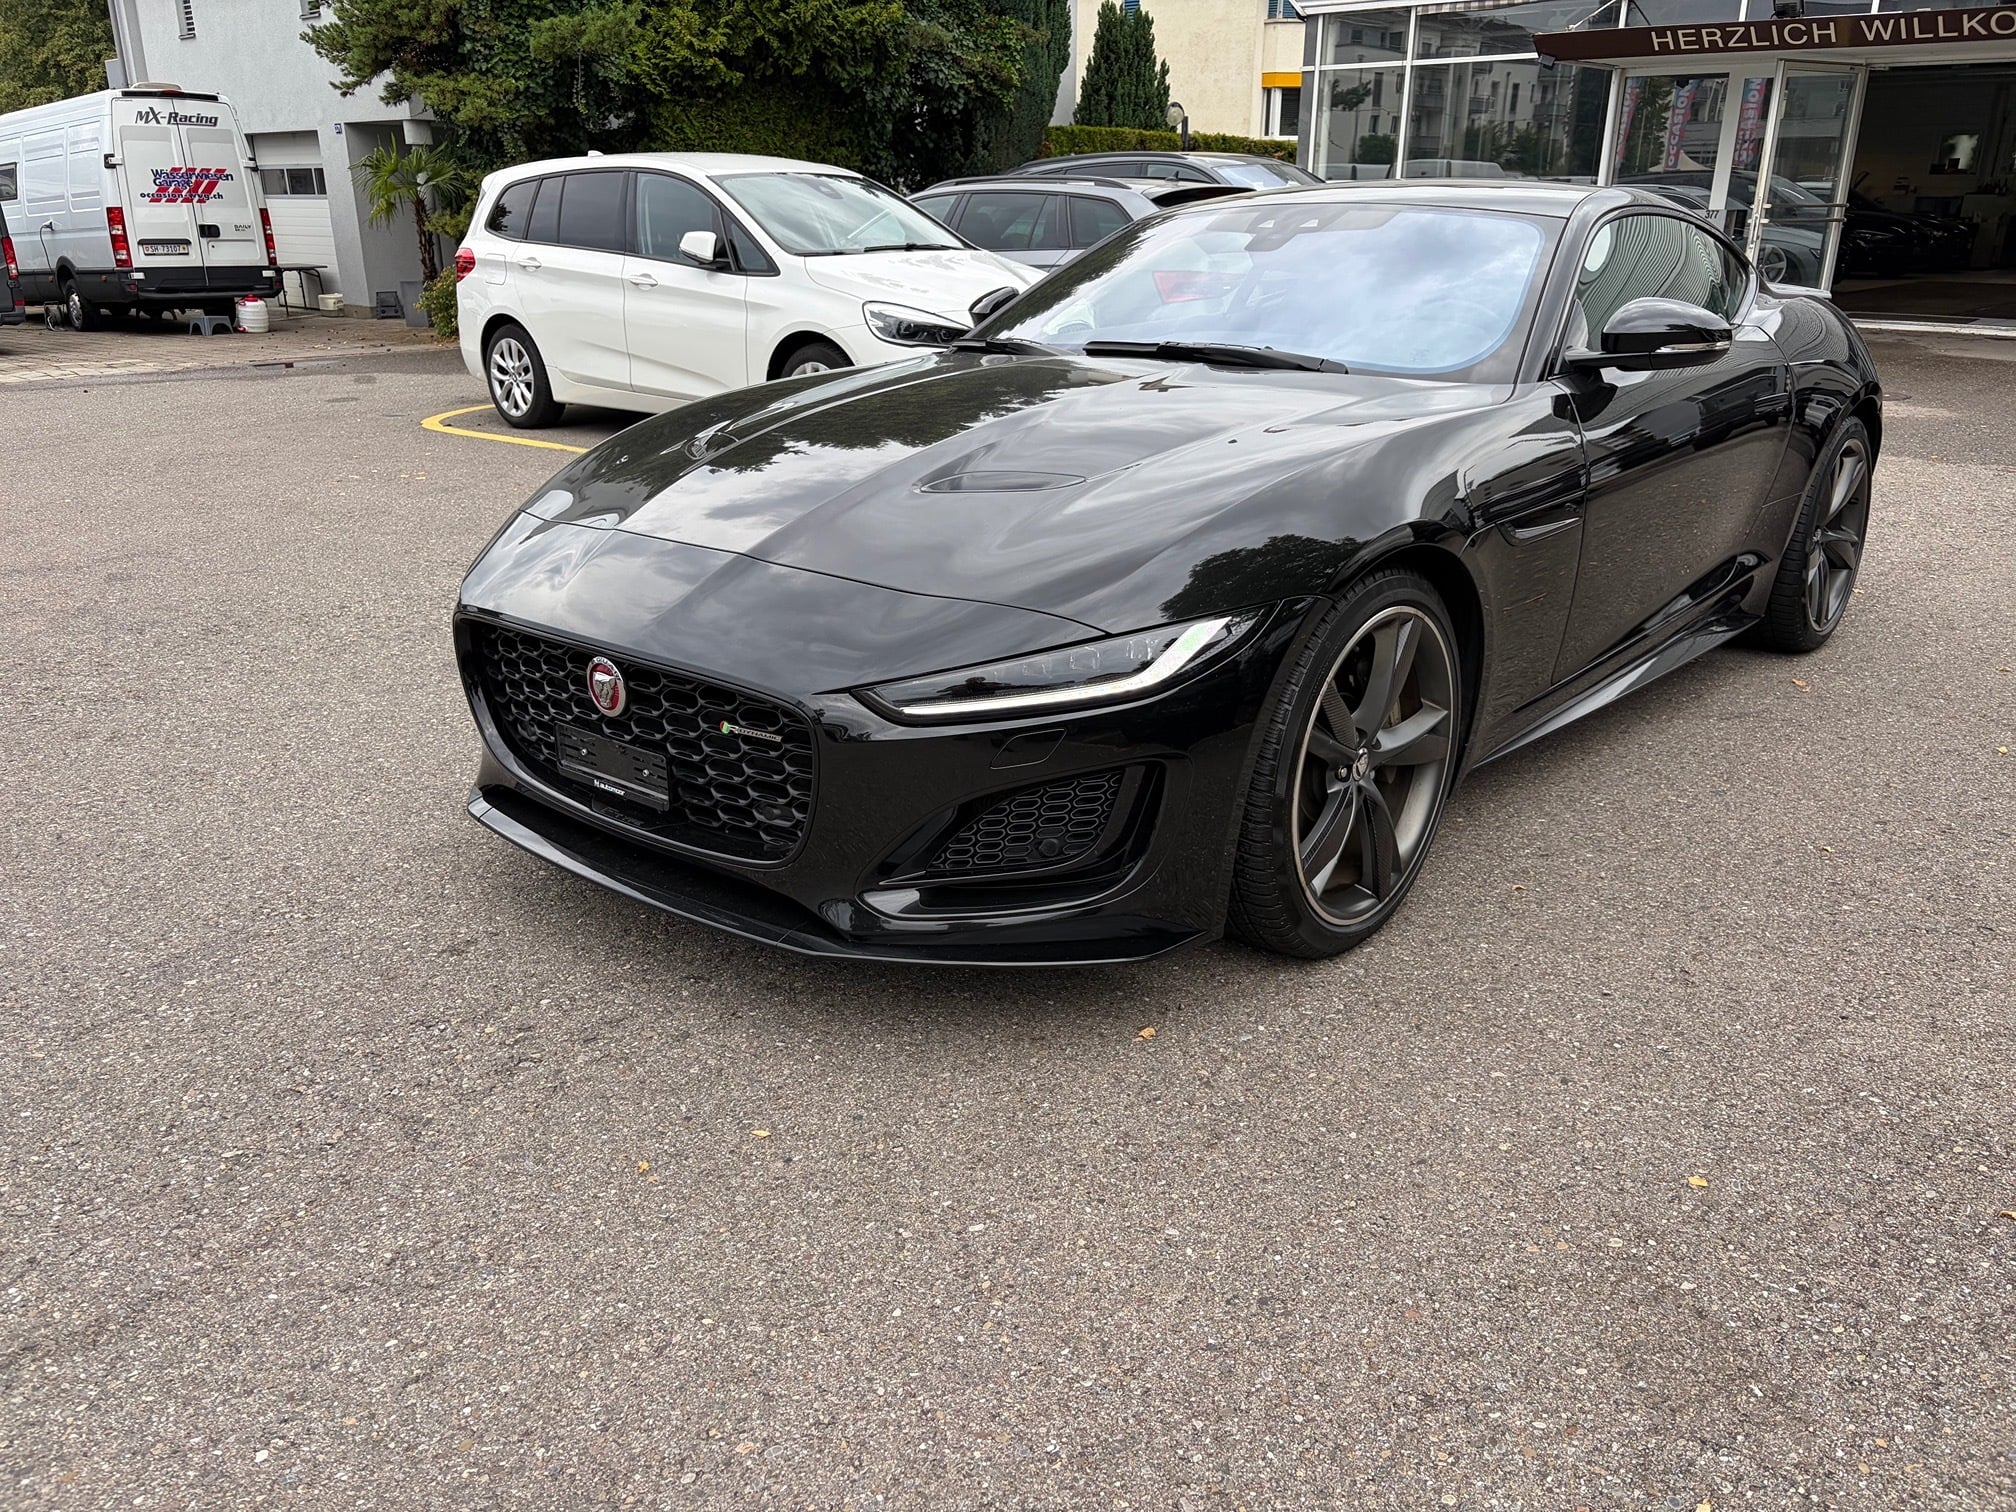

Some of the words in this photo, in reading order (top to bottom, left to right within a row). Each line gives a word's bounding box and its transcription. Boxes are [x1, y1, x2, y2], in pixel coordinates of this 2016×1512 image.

[1650, 22, 1837, 51] HERZLICH
[1860, 11, 2016, 41] WILLKO
[135, 107, 219, 127] MX-Racing
[153, 177, 193, 190] Garage
